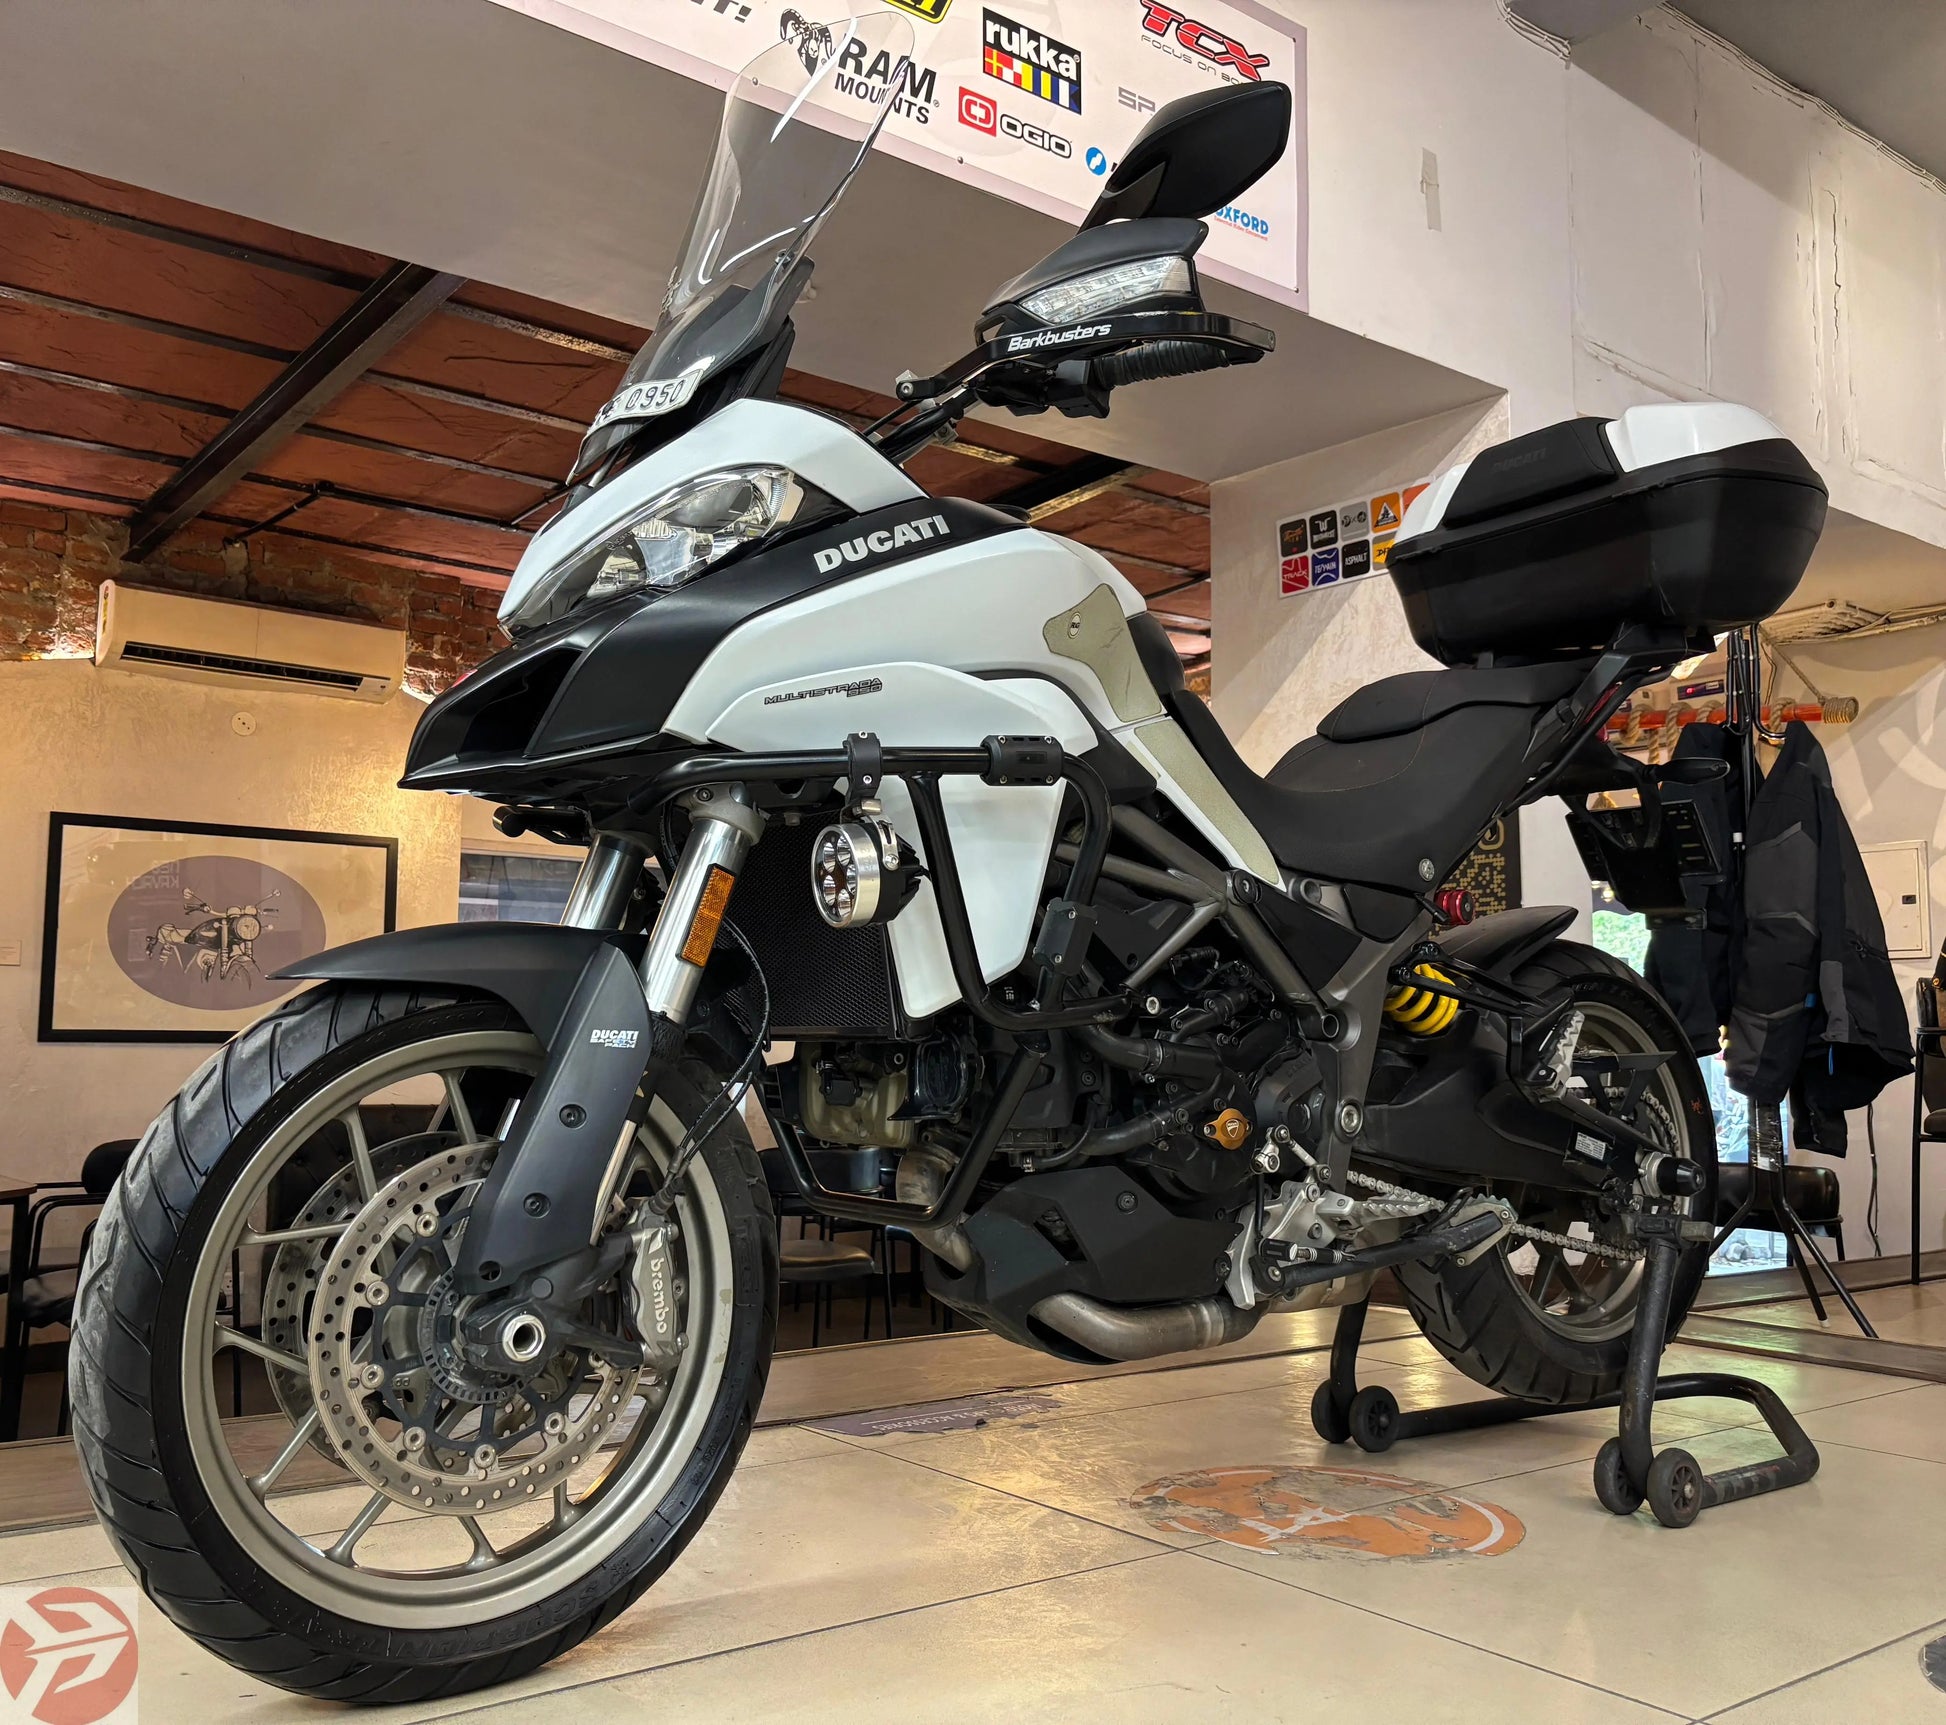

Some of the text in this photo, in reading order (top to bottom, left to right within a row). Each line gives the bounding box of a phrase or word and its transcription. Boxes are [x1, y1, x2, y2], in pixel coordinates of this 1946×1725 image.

[985, 18, 1077, 81] rukka
[1140, 0, 1270, 82] TCX
[1141, 34, 1193, 65] FOCUS
[838, 36, 937, 104] RAM
[834, 72, 931, 125] MOUNTS
[1000, 113, 1072, 159] OGIO
[1007, 324, 1112, 352] Barkbusters
[625, 379, 685, 411] 0950
[813, 514, 951, 574] DUCATI
[764, 677, 882, 705] MULTISTRADA
[590, 1029, 639, 1040] DUCATI
[650, 1257, 670, 1334] brembo
